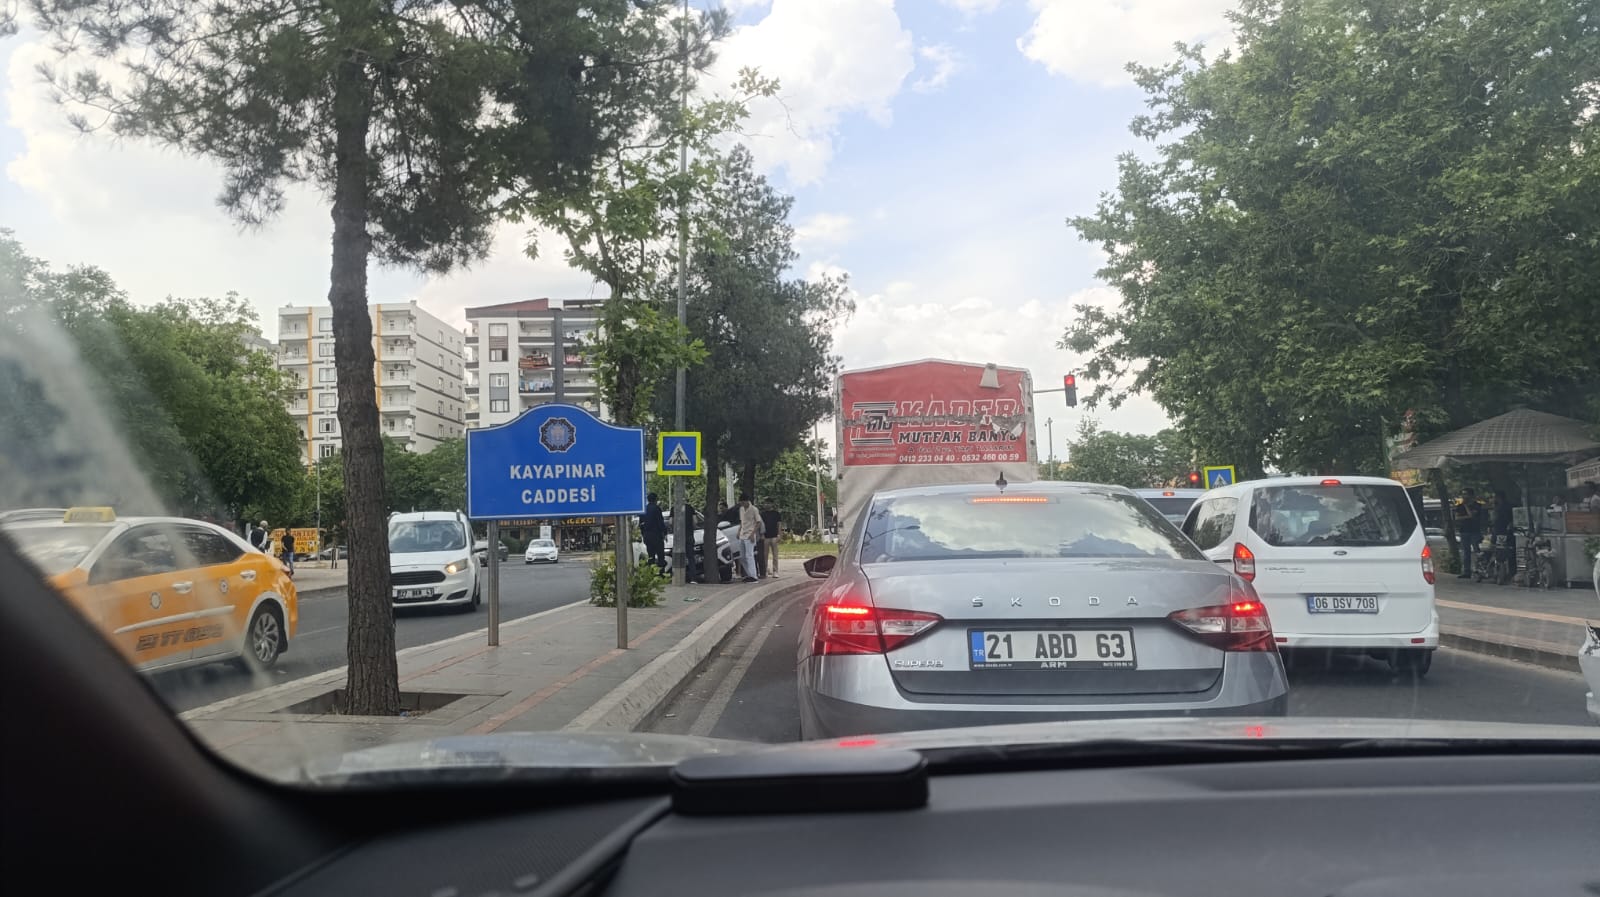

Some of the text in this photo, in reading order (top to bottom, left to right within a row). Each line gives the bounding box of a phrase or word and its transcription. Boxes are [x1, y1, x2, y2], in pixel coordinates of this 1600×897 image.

[898, 431, 961, 443] MUTFAK
[510, 463, 606, 479] KAYAPINAR
[521, 485, 596, 504] CADDESİ
[1315, 598, 1329, 608] 06
[1333, 598, 1353, 608] DSV
[1356, 598, 1375, 608] 708
[986, 633, 1014, 659] 21
[1035, 633, 1078, 659] ABD
[1096, 633, 1126, 658] 63
[1040, 661, 1067, 669] ARM
